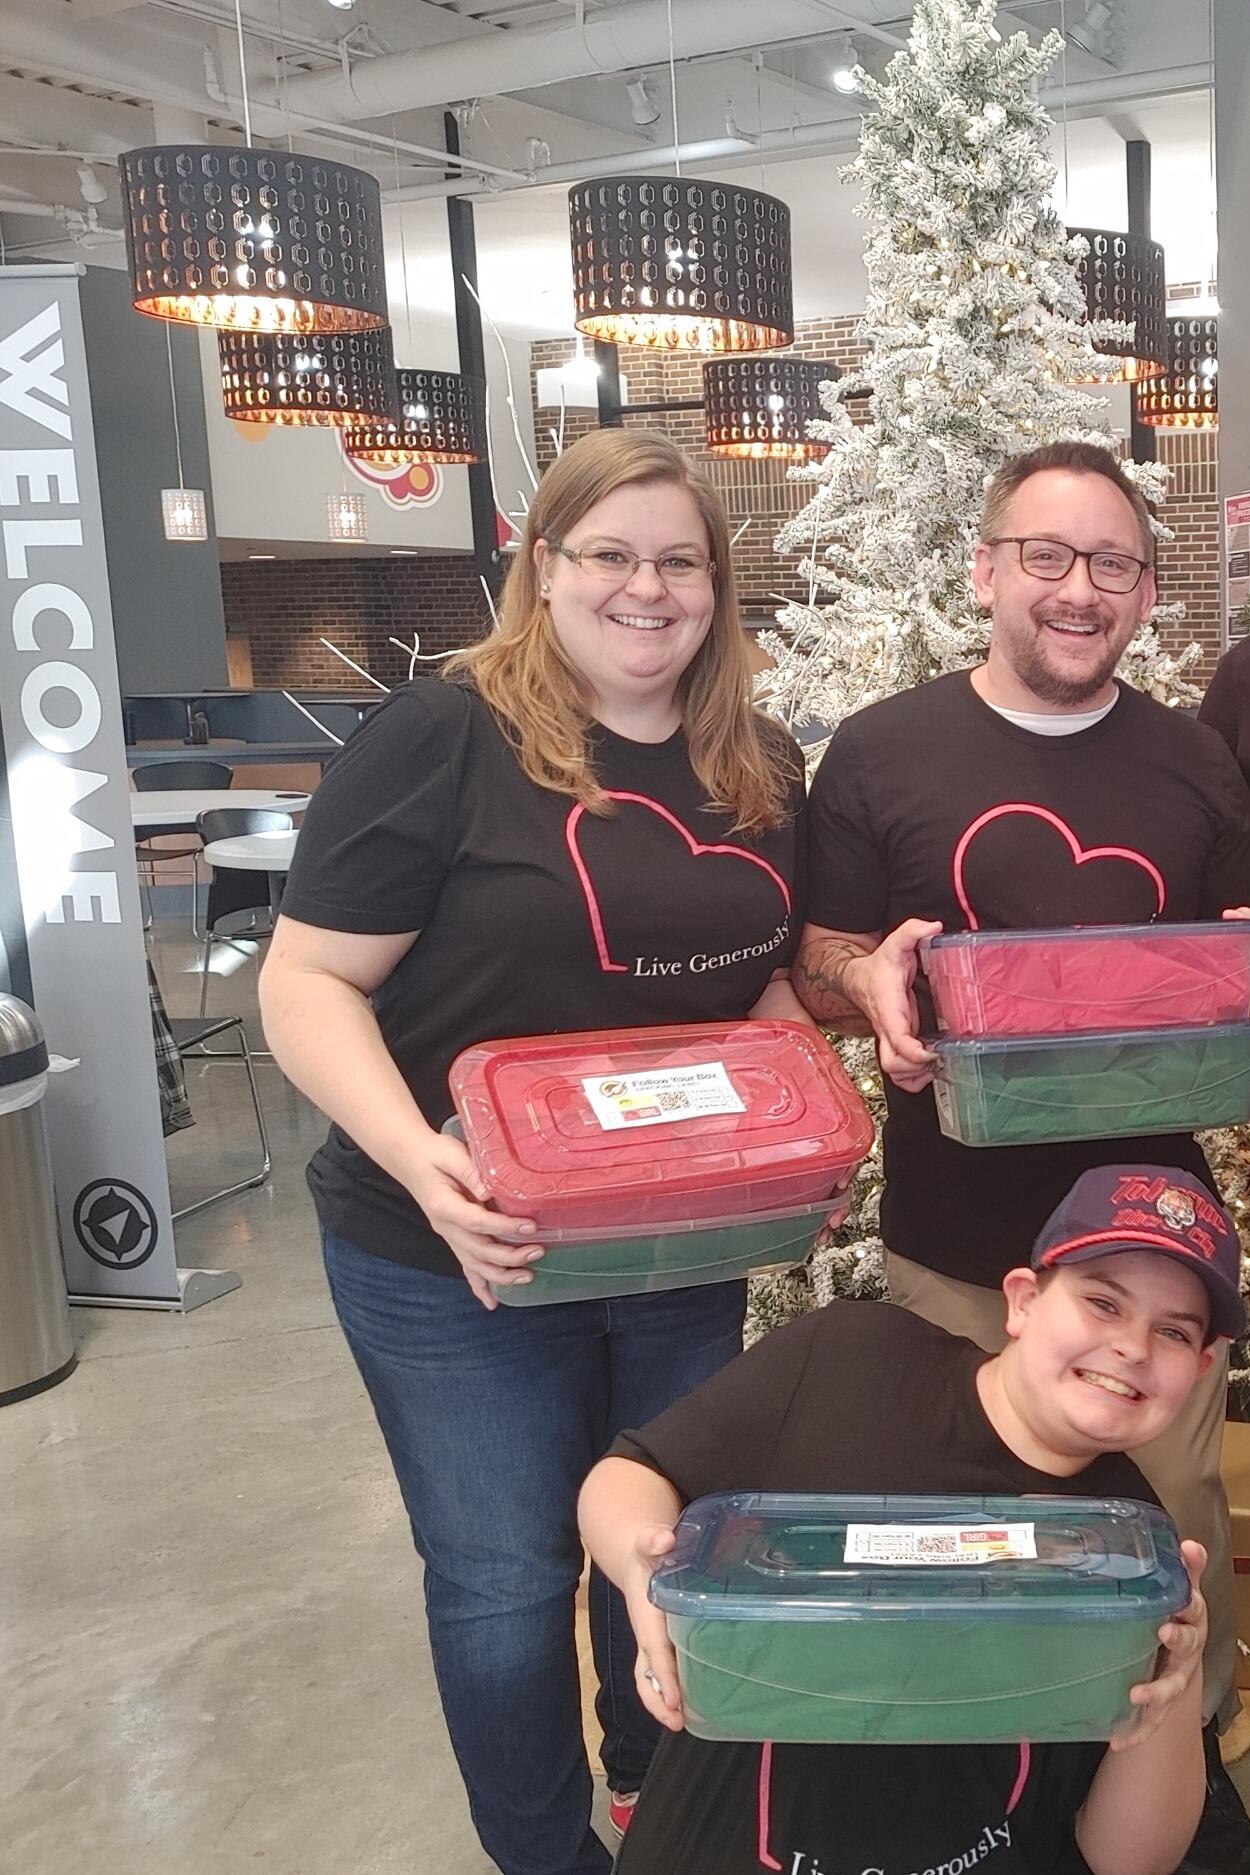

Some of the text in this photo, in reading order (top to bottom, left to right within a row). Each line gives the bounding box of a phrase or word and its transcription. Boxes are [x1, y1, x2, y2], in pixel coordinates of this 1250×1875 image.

[0, 300, 122, 925] WELCOME
[633, 914, 791, 977] Live Generously
[631, 1073, 718, 1088] Follow Your Box
